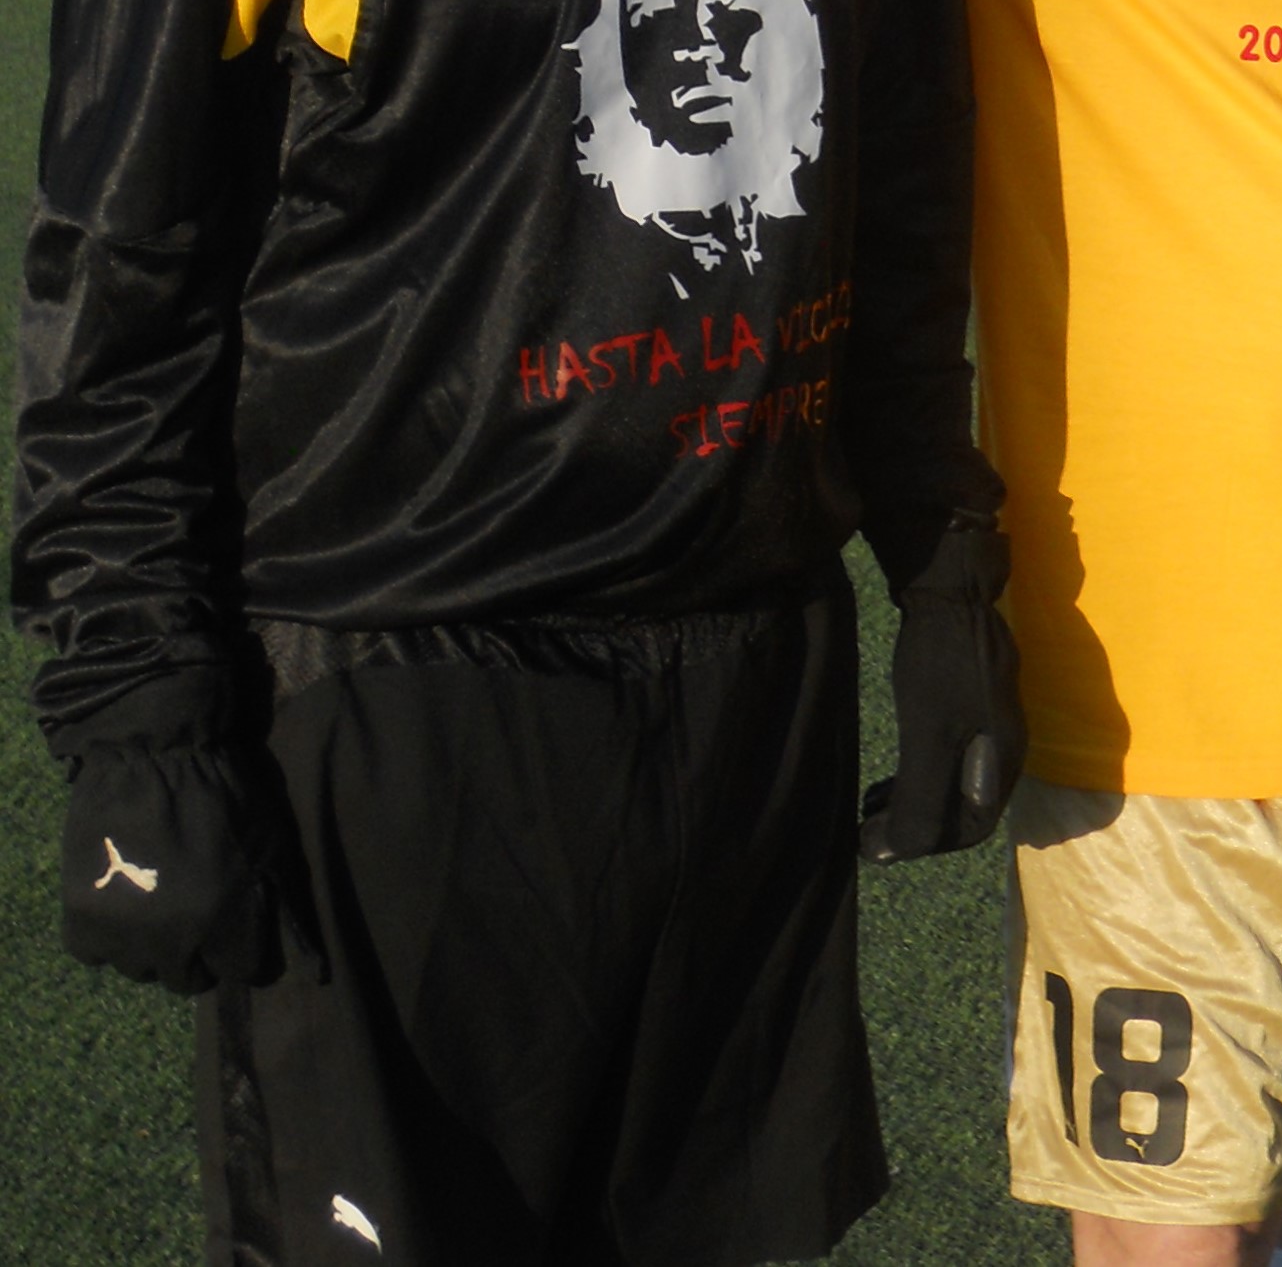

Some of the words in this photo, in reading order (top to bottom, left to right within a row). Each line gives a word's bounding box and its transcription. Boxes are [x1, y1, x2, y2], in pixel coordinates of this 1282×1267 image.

[519, 328, 684, 402] HASTA
[701, 314, 764, 371] LA
[1045, 970, 1192, 1166] 18
